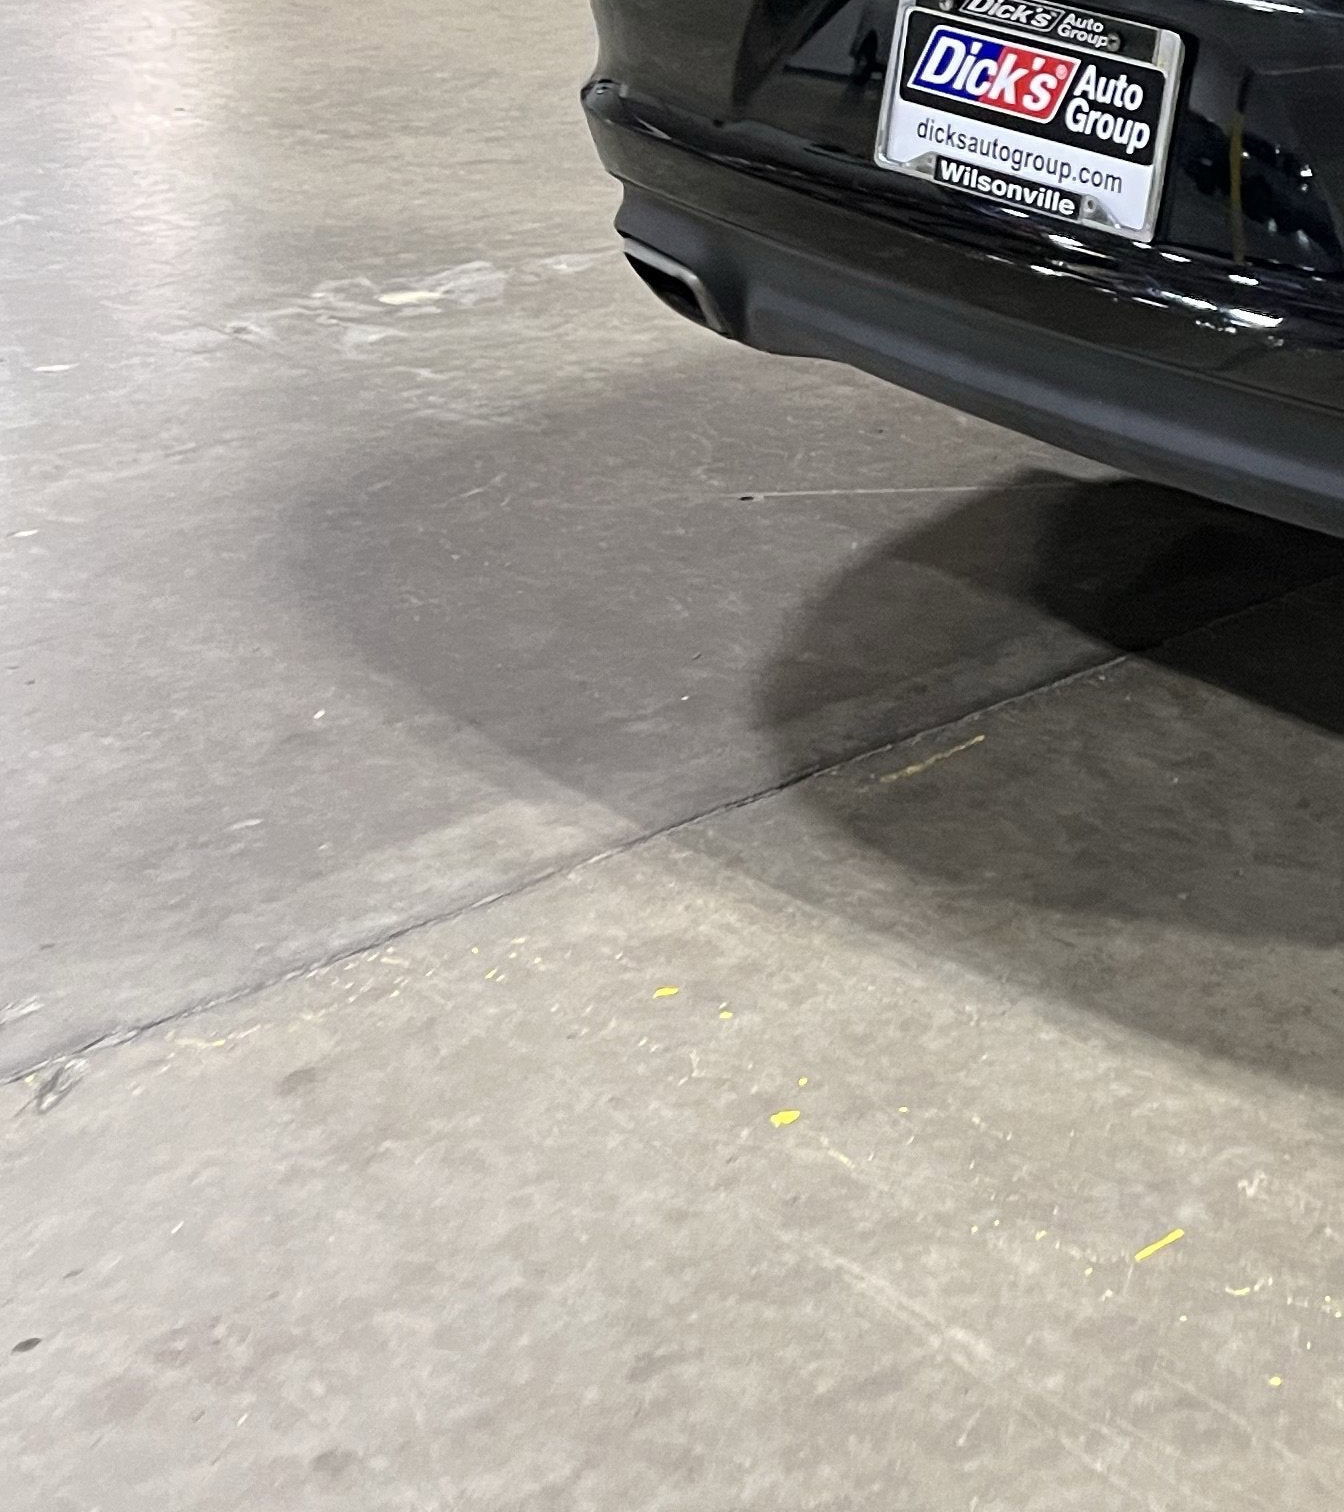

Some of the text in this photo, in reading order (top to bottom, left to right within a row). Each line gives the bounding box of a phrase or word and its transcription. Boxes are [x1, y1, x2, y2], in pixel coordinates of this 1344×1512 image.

[1057, 24, 1109, 49] Group
[1063, 13, 1104, 32] Auto
[920, 36, 1058, 112] Dick's
[1073, 64, 1144, 111] Auto
[1065, 97, 1150, 155] Group
[917, 117, 1123, 194] dicksautogroup.com
[939, 159, 1076, 216] Wilsonville
